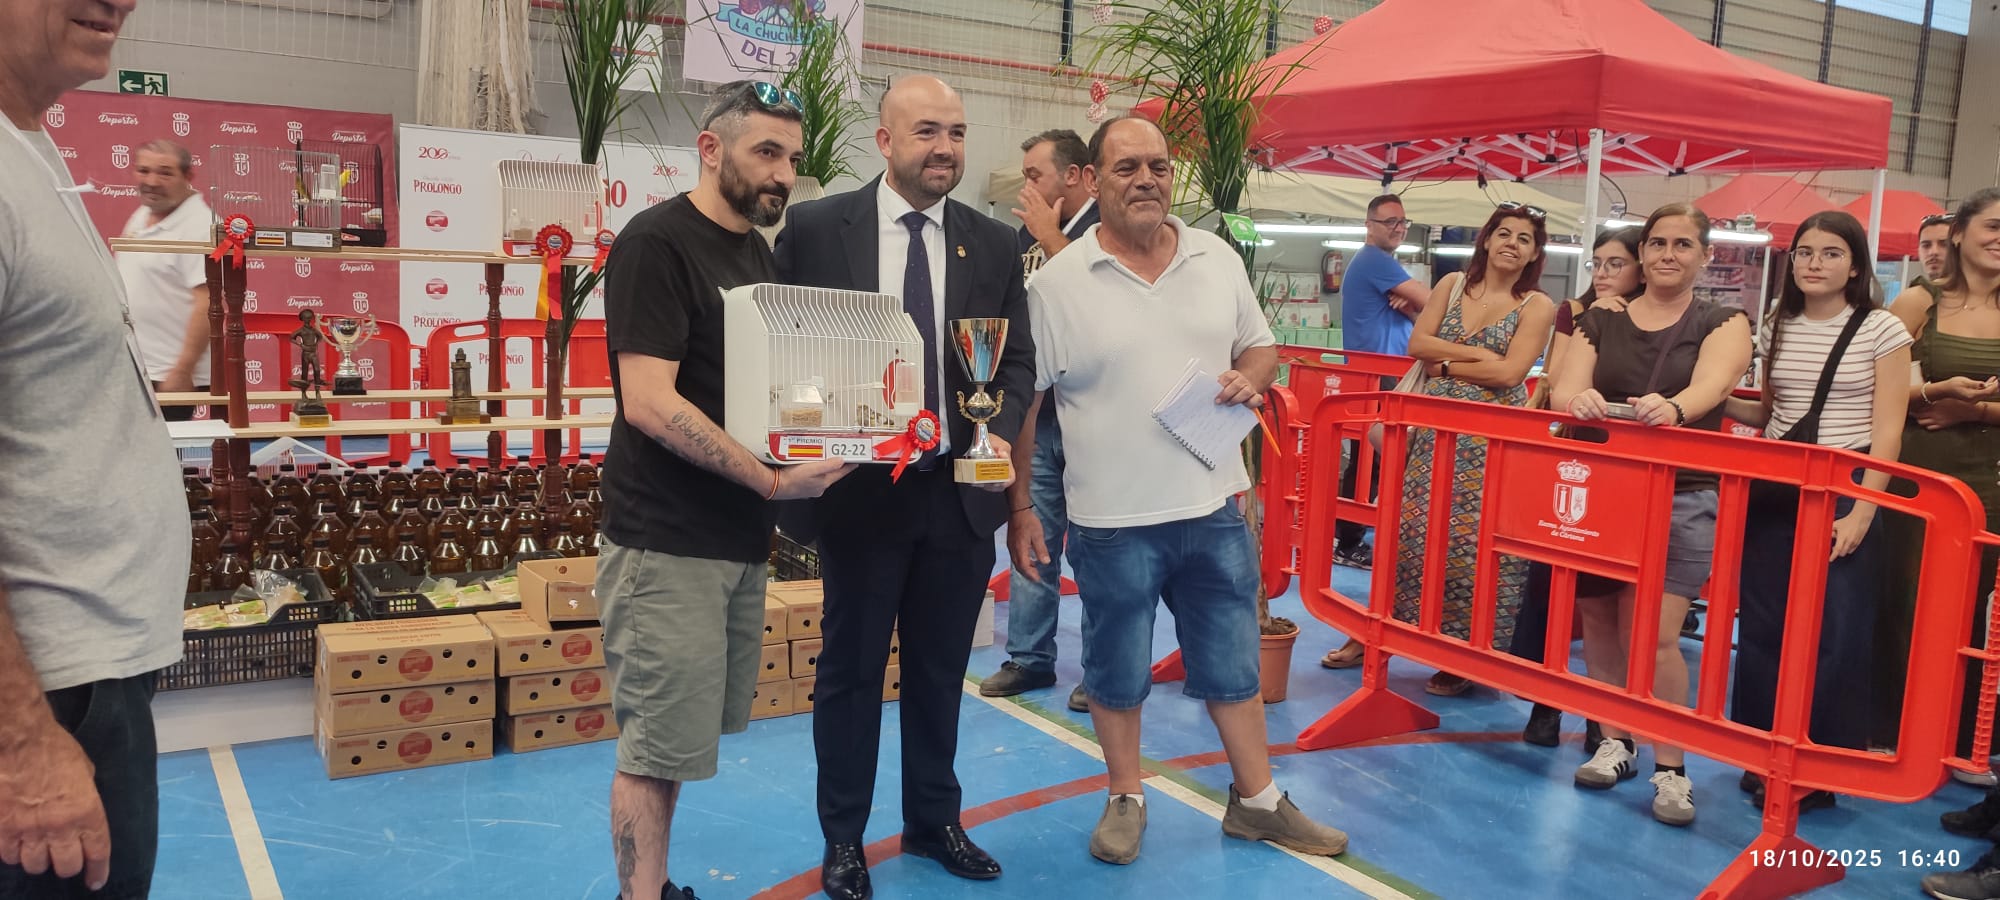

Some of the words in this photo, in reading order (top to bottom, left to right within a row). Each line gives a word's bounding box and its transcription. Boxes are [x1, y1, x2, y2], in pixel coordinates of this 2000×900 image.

[735, 19, 750, 32] LA
[741, 40, 779, 66] DEL
[98, 114, 139, 126] Deportes
[219, 122, 258, 135] Deportes
[331, 132, 367, 143] Deportes
[413, 179, 462, 195] PROLONGO
[339, 262, 375, 273] Deportes
[286, 298, 324, 309] Deportes
[831, 443, 866, 456] G2-22
